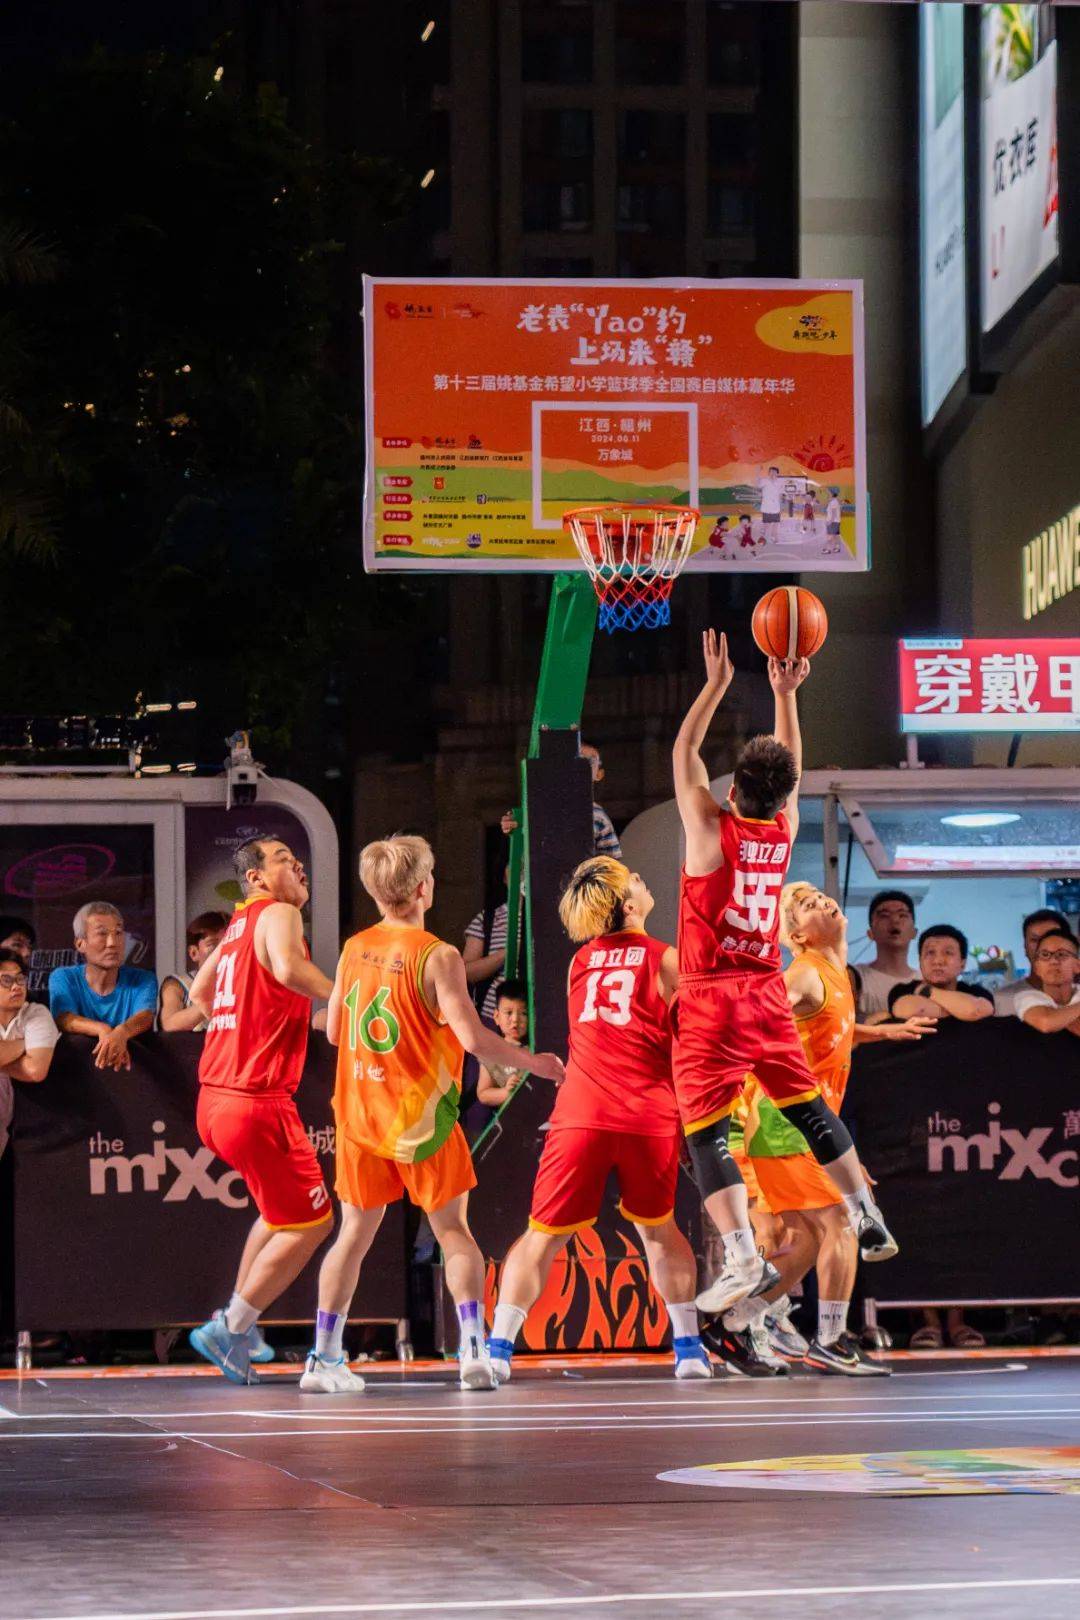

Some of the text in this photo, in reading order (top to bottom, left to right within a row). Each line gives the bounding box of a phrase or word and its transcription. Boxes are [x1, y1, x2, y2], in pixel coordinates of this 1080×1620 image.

[724, 869, 783, 934] 55
[343, 978, 400, 1054] 16
[578, 969, 636, 1026] 13
[90, 1132, 125, 1153] the
[928, 1111, 961, 1132] the
